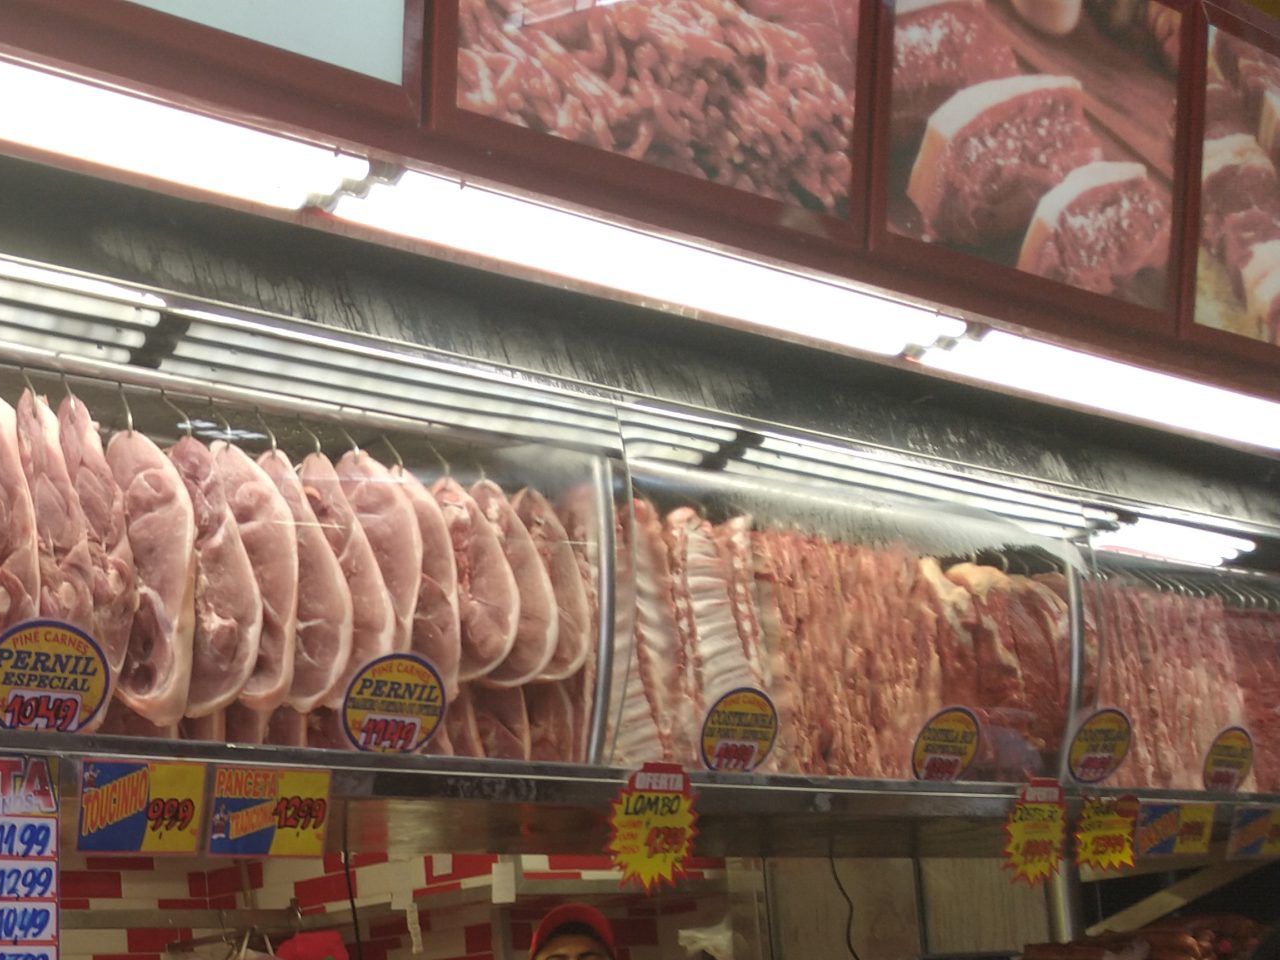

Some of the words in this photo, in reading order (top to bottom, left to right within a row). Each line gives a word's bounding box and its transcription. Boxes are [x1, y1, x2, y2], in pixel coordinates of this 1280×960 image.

[44, 630, 90, 657] CARNES
[1, 672, 91, 692] ESPECIAL
[356, 677, 440, 703] PERNIL
[216, 768, 277, 798] PANCETA
[82, 765, 149, 837] TOUCINHO
[624, 795, 681, 817] LOMBO
